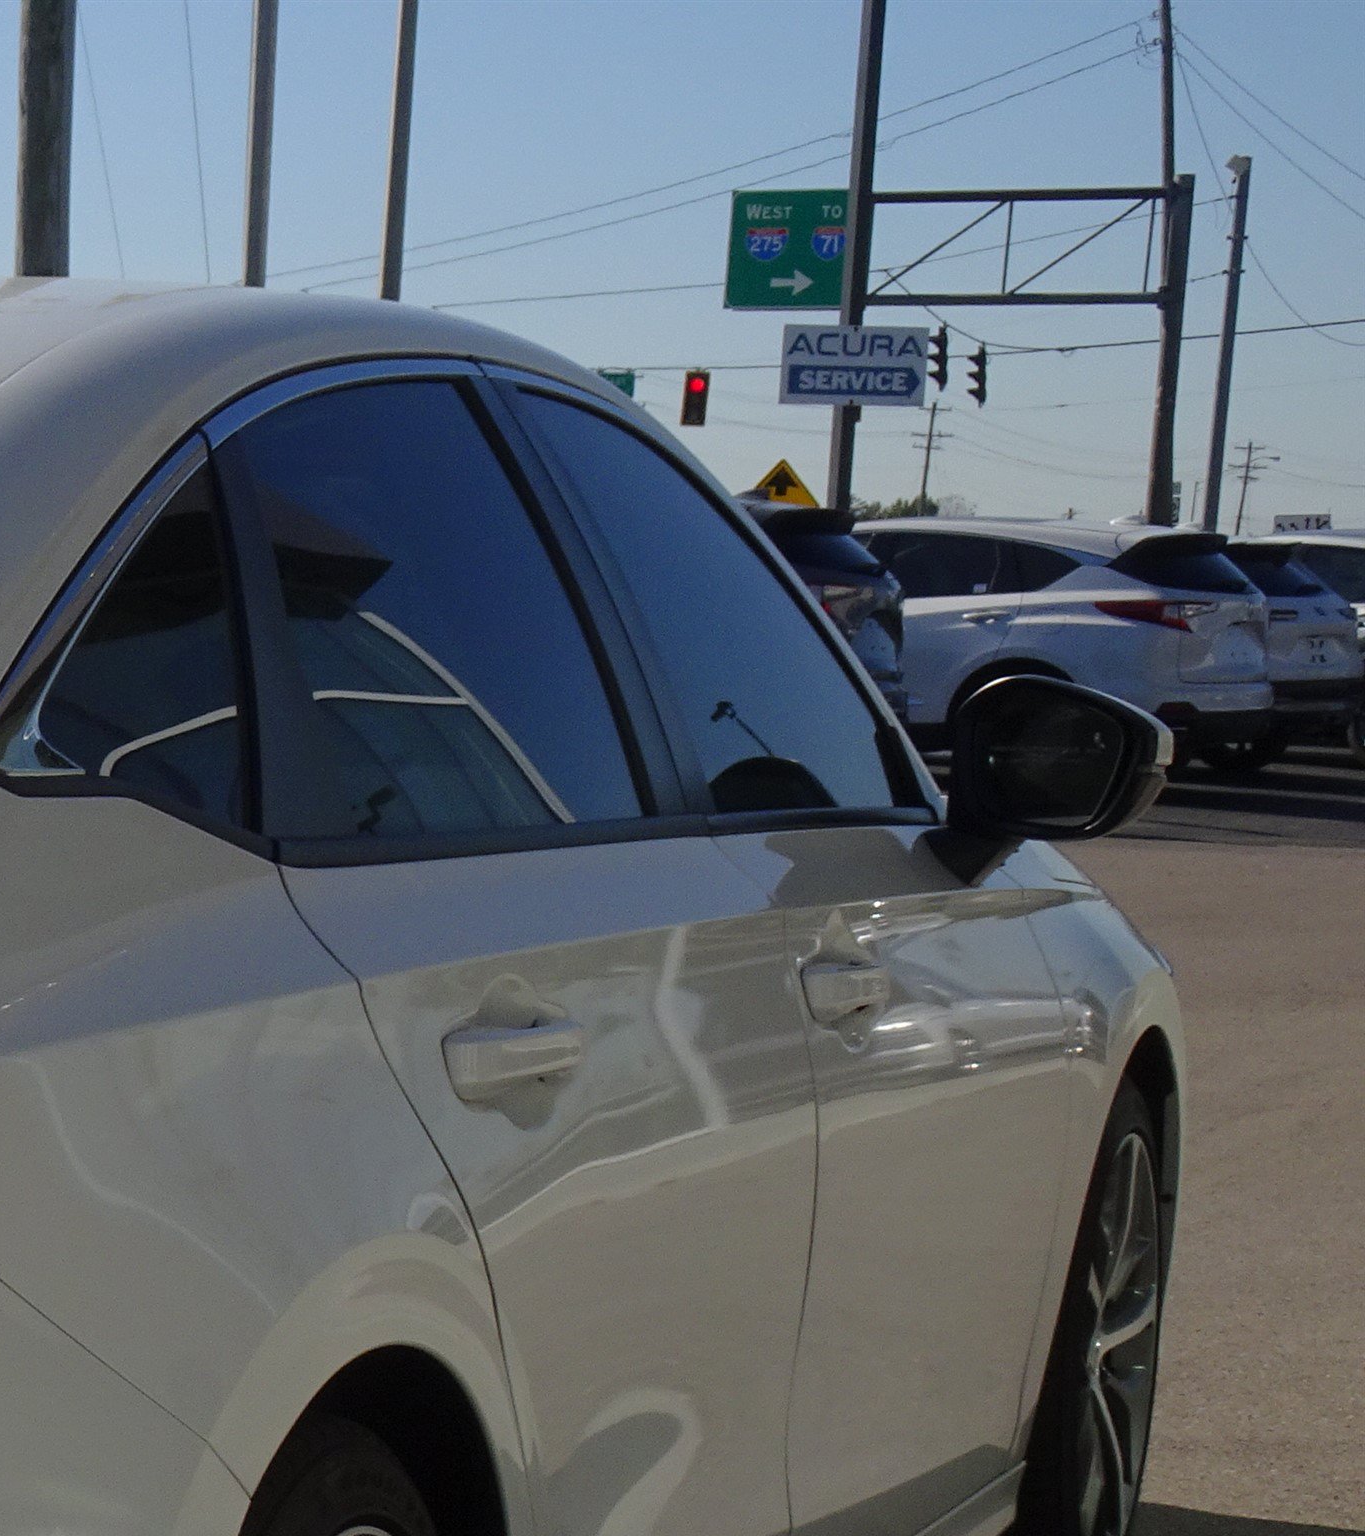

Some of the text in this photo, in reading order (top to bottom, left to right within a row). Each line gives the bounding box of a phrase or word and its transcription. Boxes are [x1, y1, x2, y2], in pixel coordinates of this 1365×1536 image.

[746, 204, 843, 220] WEST TO
[750, 236, 783, 252] 275
[821, 235, 839, 253] 71
[787, 333, 922, 357] ACURA
[798, 370, 909, 392] SERVICE
